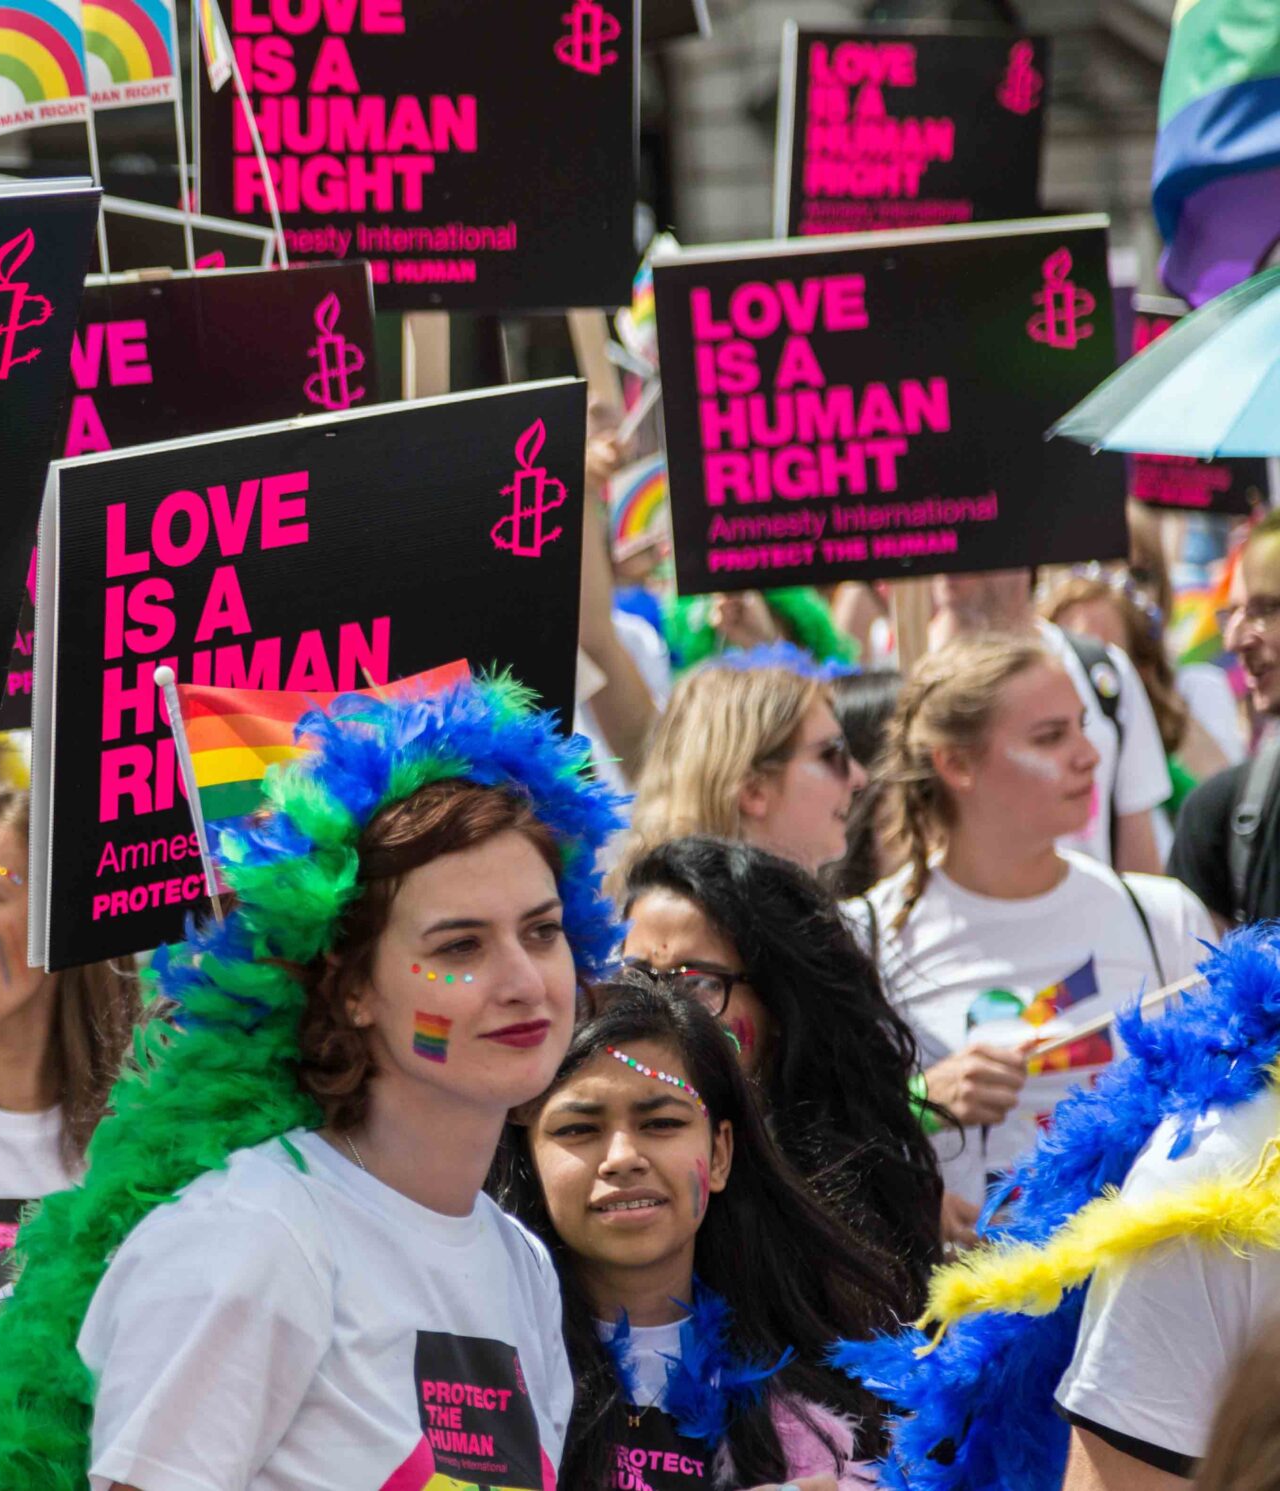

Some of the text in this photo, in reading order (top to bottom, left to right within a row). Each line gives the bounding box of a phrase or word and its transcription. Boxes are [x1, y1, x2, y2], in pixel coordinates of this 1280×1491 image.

[232, 0, 405, 35] LOVE
[231, 36, 297, 95] IS
[308, 36, 360, 94] A
[810, 41, 917, 86] LOVE
[39, 102, 87, 119] RIGHT
[124, 83, 171, 98] RIGHT
[232, 95, 477, 154] HUMAN
[233, 154, 435, 214] RIGHT
[357, 221, 516, 252] International
[691, 274, 868, 342] LOVE
[695, 336, 825, 398] IS A
[64, 395, 114, 459] A
[699, 376, 951, 452] HUMAN
[705, 438, 908, 506] RIGHT
[105, 470, 309, 578] LOVE
[707, 490, 998, 543] Amnesty International
[707, 541, 815, 573] PROTECT
[103, 565, 253, 660] IS A
[422, 1380, 512, 1412] PROTECT
[424, 1404, 462, 1429] THE
[427, 1427, 494, 1457] HUMAN
[462, 1459, 508, 1473] International
[616, 1443, 705, 1478] ROTECT
